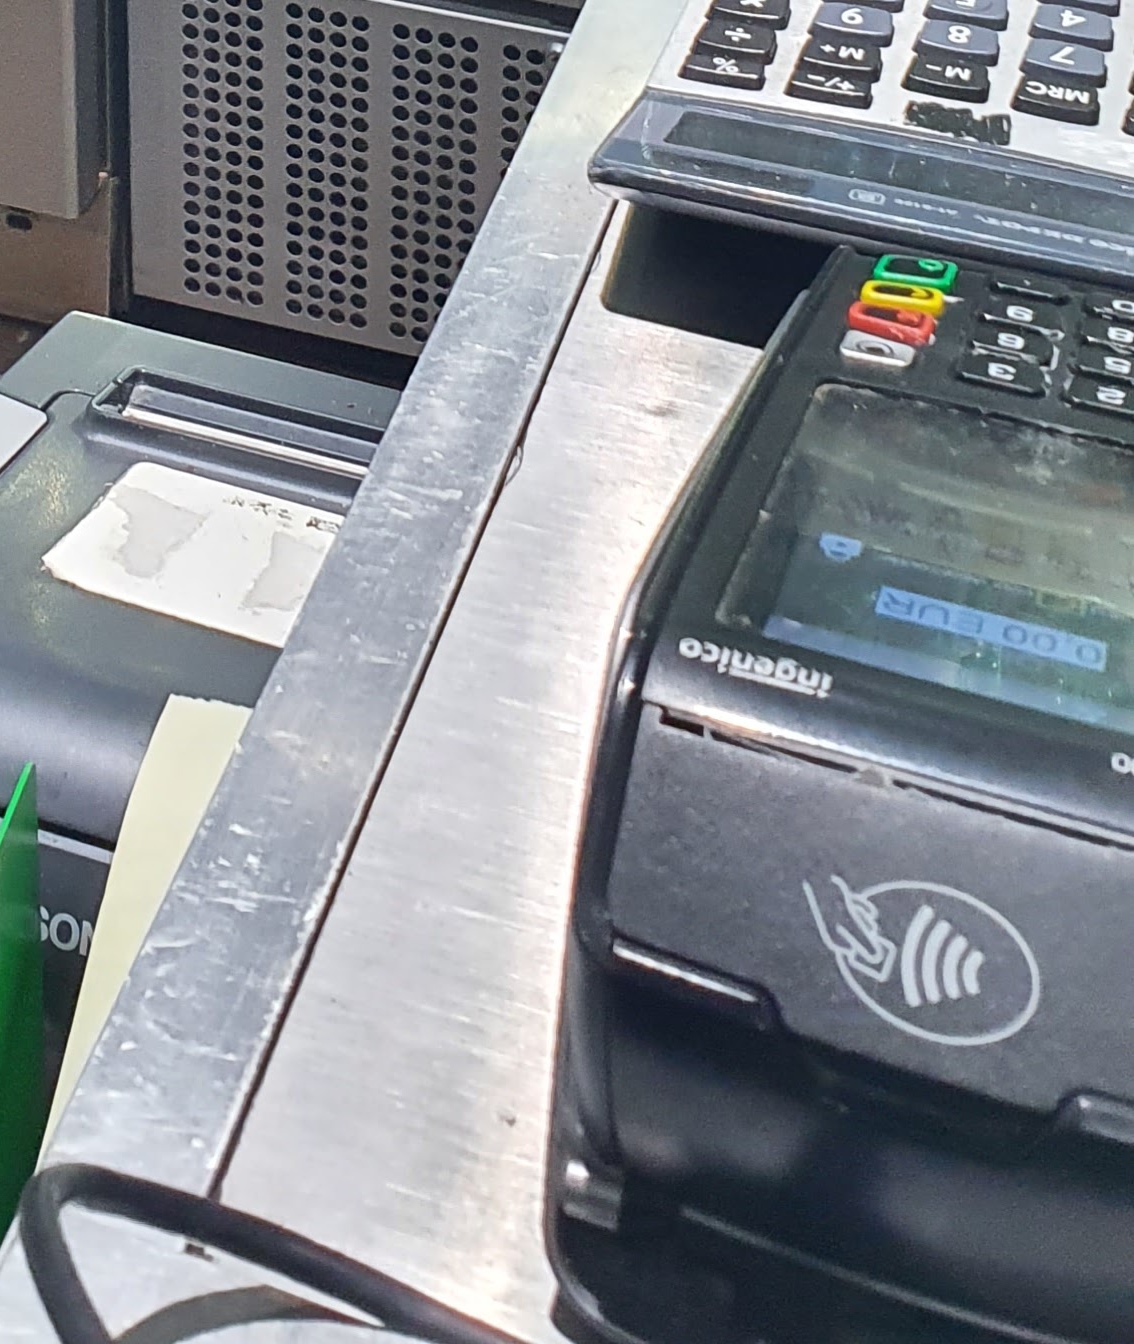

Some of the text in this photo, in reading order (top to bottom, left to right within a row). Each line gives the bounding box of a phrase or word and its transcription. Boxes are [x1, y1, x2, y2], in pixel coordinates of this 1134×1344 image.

[1025, 81, 1091, 105] MRC
[882, 589, 985, 637] EUR
[678, 635, 834, 699] ingenico
